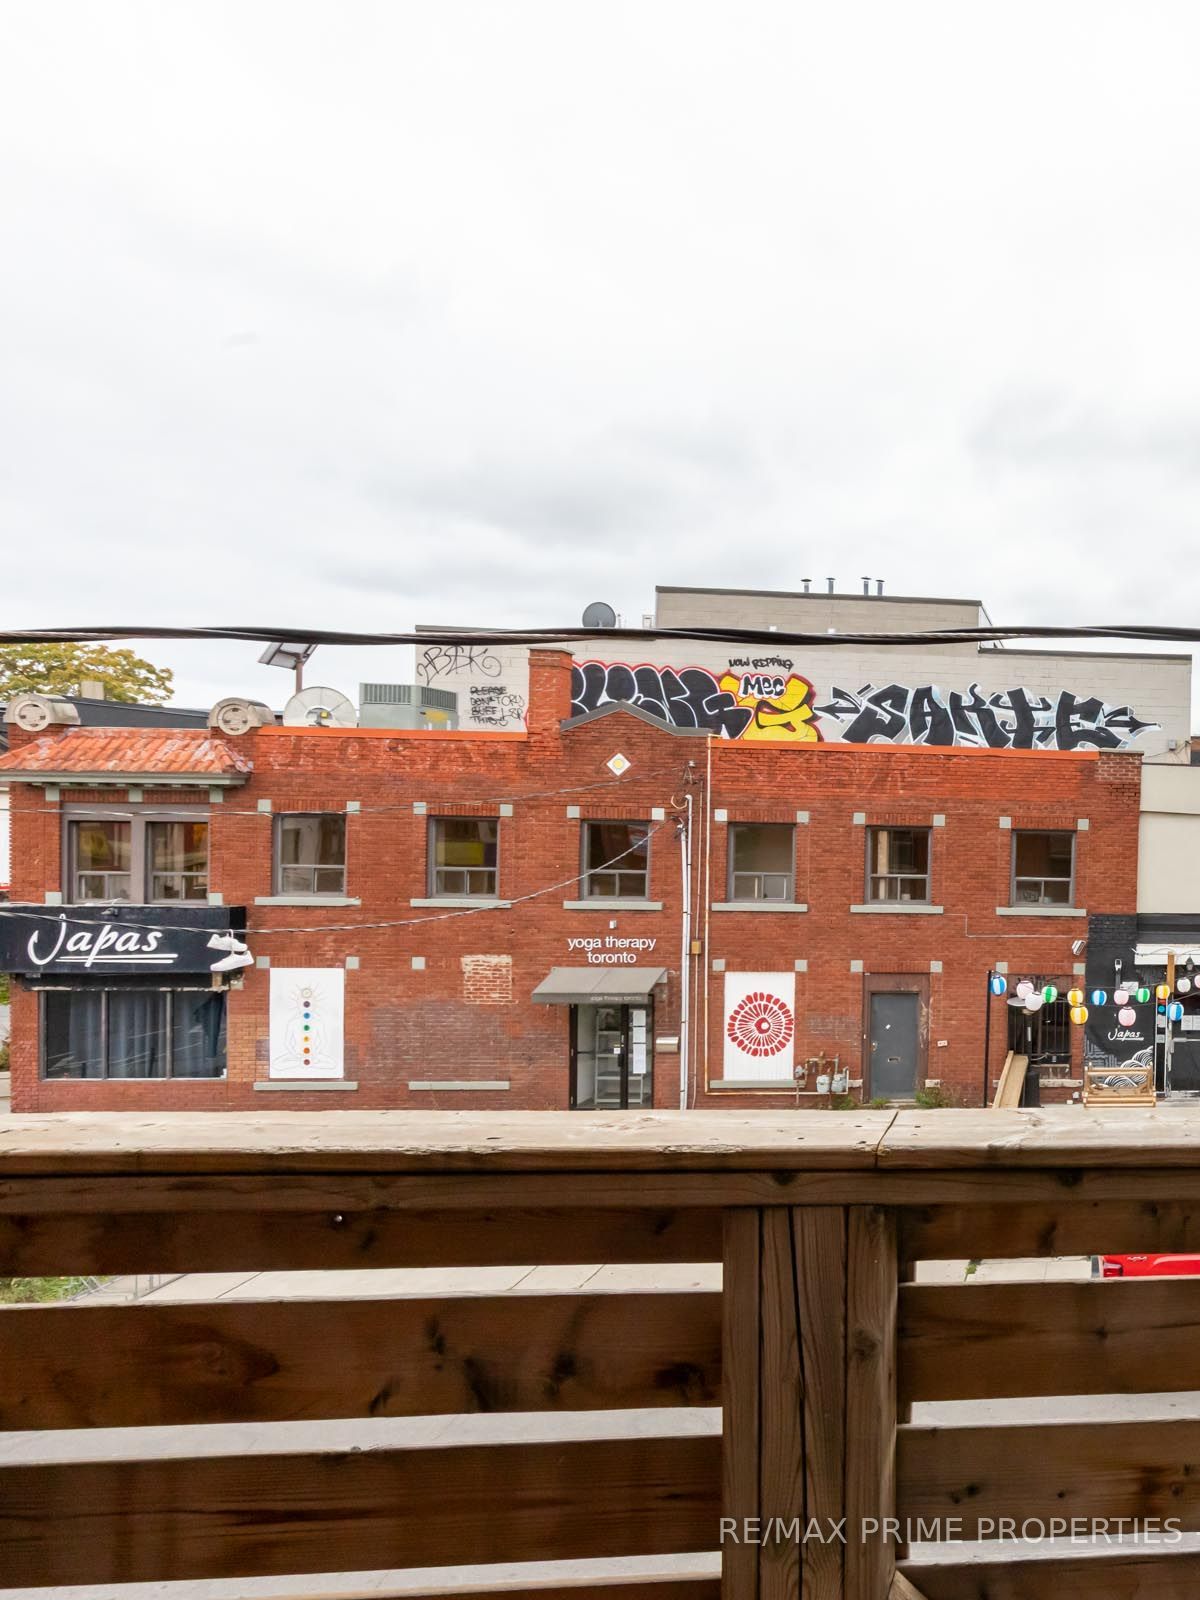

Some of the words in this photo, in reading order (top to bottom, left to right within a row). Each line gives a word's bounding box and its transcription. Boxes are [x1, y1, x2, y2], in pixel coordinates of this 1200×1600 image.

[28, 913, 163, 967] Japas
[568, 938, 601, 950] yoga
[605, 936, 656, 950] therapy
[587, 952, 637, 964] toronto
[1107, 1028, 1141, 1042] Japas
